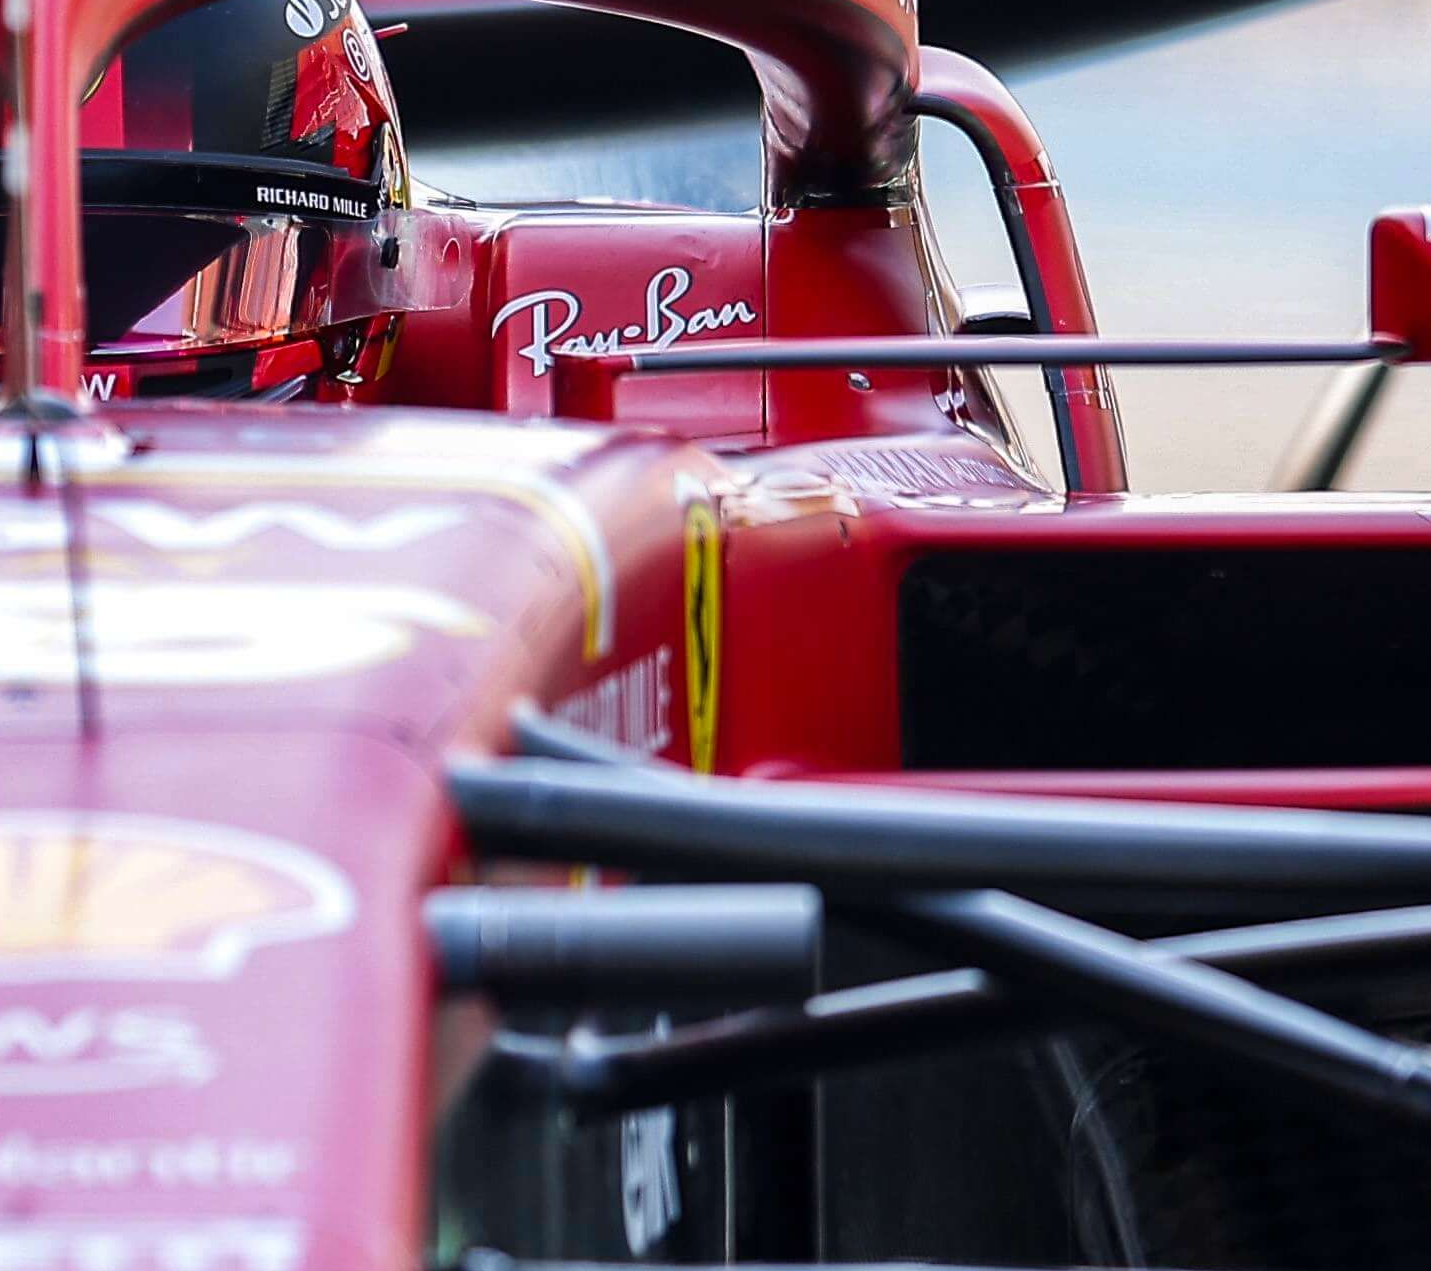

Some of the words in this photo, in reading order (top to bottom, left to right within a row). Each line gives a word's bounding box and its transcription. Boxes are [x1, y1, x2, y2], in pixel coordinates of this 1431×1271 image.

[255, 186, 330, 212] RICHARD
[332, 196, 368, 220] MILLE
[491, 266, 757, 378] Ray-Ban
